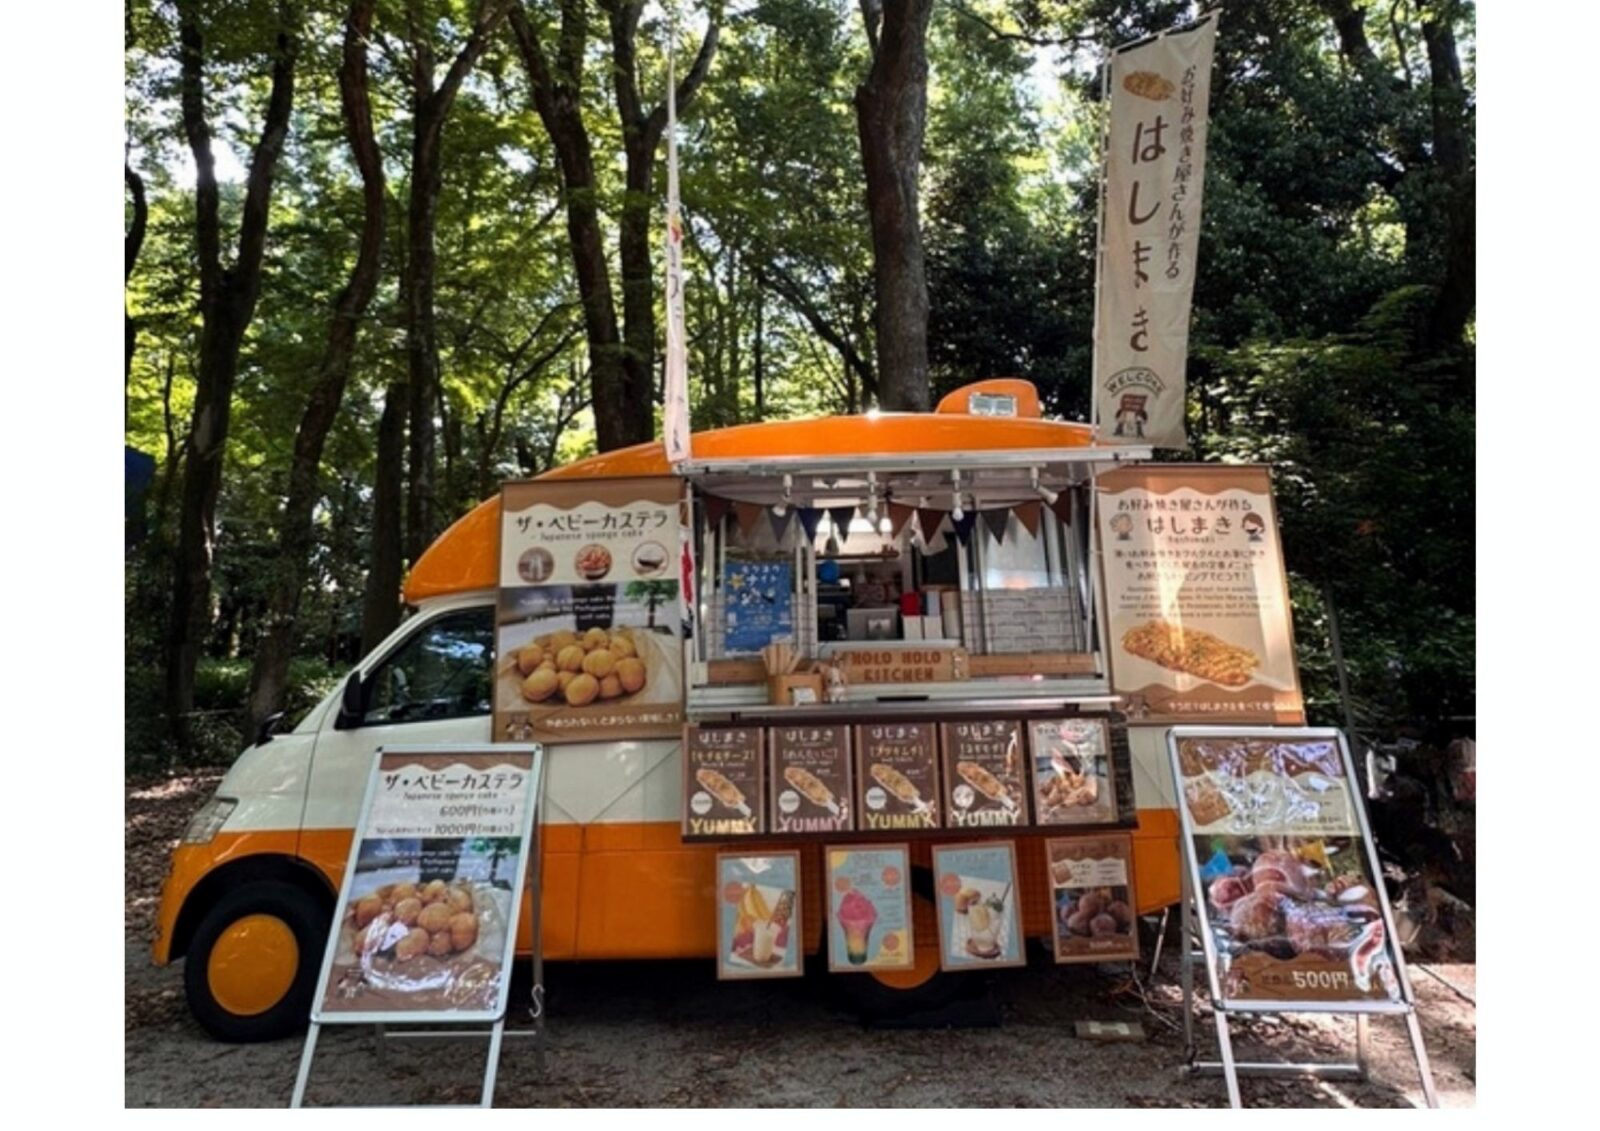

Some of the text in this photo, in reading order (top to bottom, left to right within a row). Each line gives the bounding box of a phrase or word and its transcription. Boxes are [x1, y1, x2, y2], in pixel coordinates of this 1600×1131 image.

[1128, 114, 1169, 352] はしまき
[515, 509, 669, 534] ザ・ベビーカステラ
[1146, 515, 1233, 536] はしまき
[385, 773, 524, 791] ザ・ベビーカステラ
[690, 817, 757, 833] YUMMY
[779, 816, 845, 832] YUMMY
[866, 812, 936, 829] YUMMY
[953, 809, 1021, 827] YUMMY
[1292, 970, 1349, 990] 500円
